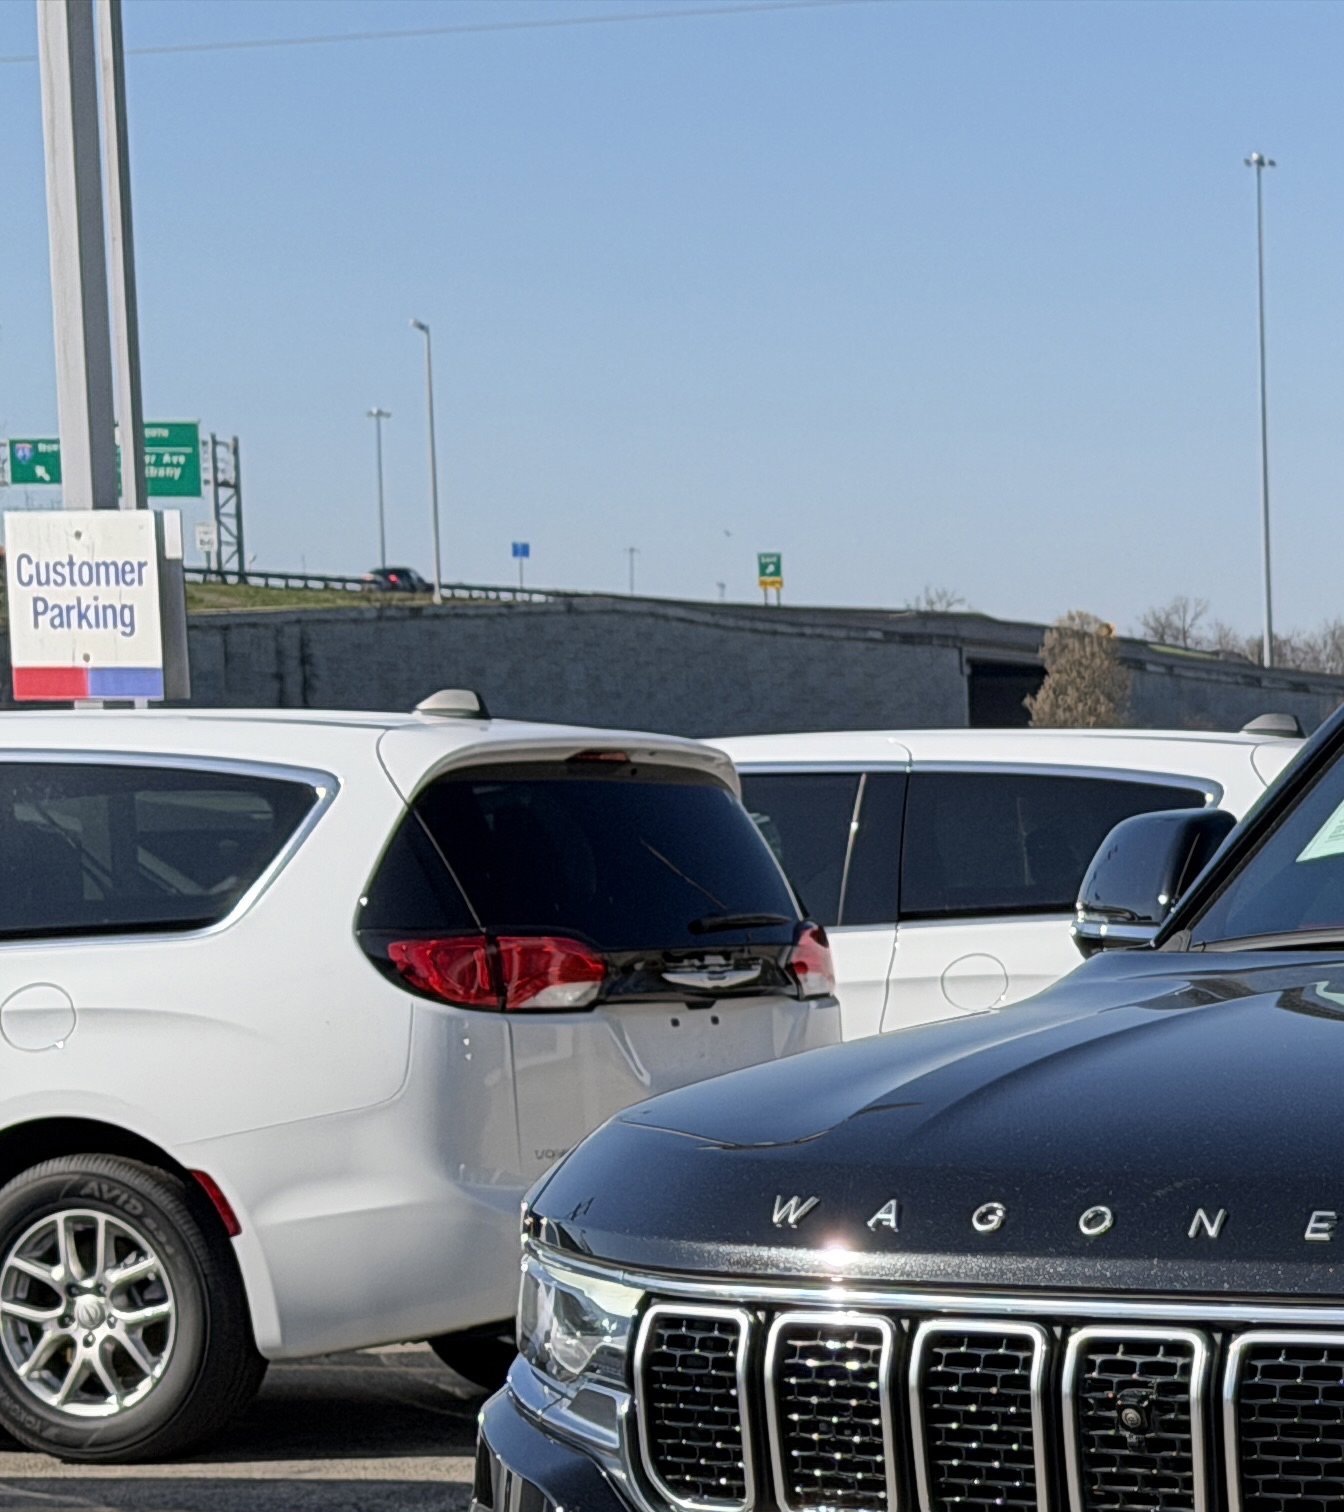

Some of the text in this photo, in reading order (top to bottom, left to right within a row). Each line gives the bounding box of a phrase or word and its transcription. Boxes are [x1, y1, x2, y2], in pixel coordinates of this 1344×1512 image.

[16, 553, 148, 588] Customer
[32, 596, 135, 637] Parking
[80, 1180, 144, 1216] AVID
